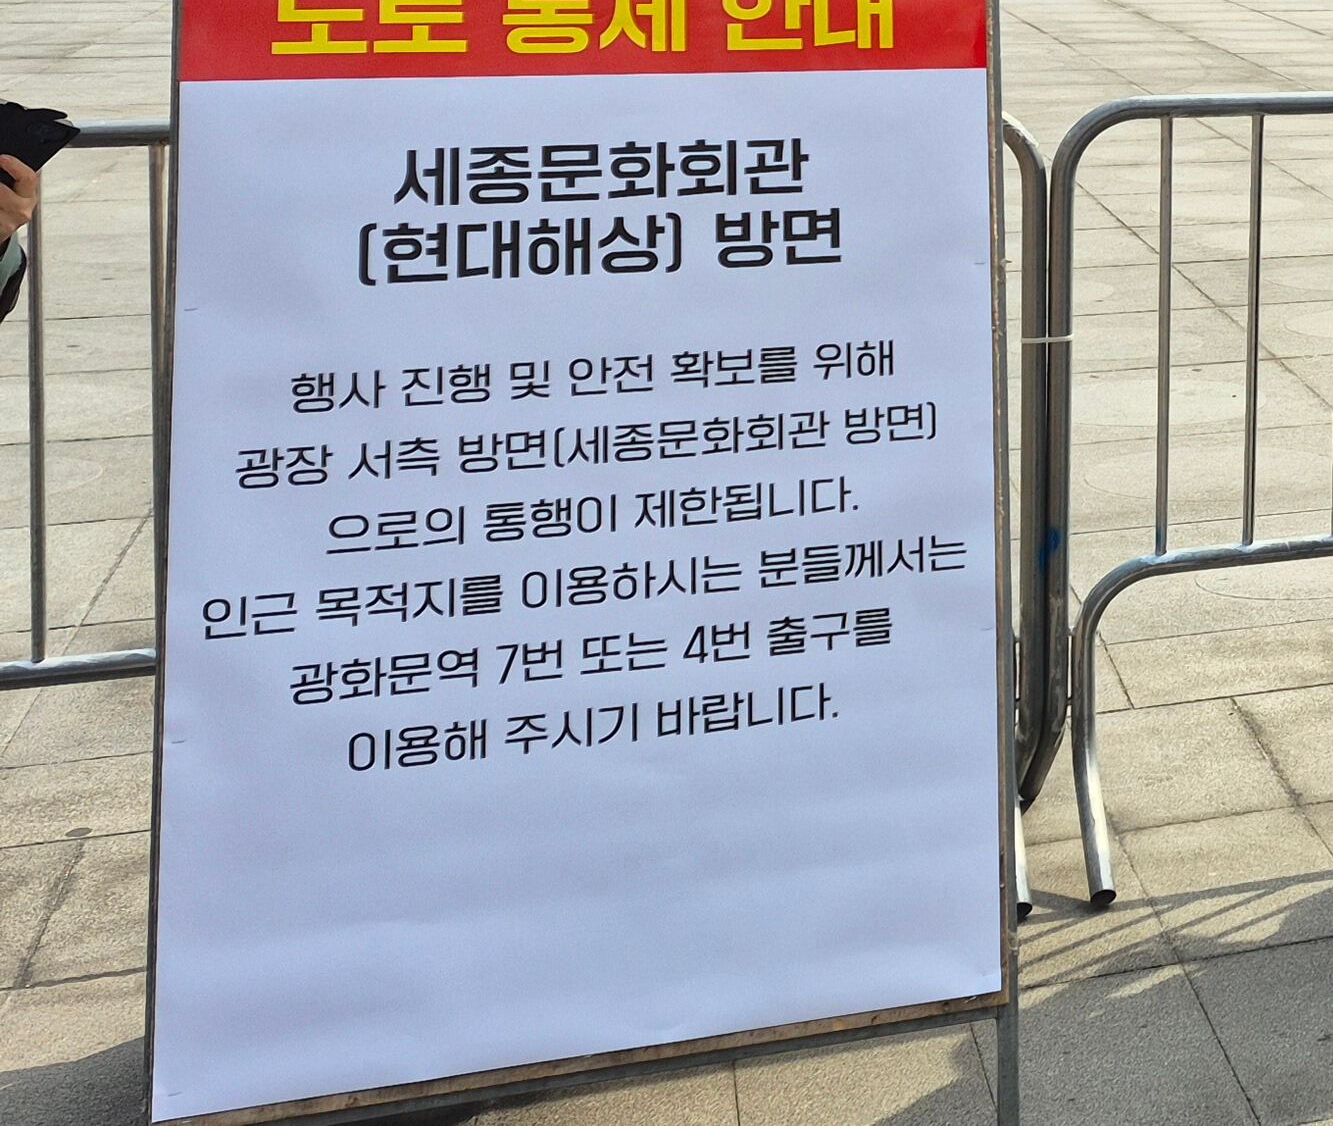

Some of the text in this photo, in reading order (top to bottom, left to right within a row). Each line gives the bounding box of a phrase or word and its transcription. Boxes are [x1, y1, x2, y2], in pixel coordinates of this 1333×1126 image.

[395, 139, 810, 206] 세종문화회관
[359, 208, 843, 288] (현대해상) 방면
[291, 340, 895, 414] 행사 진행 및 안전 확보를 위해
[236, 445, 334, 491] 광장
[349, 437, 441, 481] 서측
[845, 402, 938, 446] 방면)
[326, 476, 860, 555] 으로의 통행이 제한됩니다.
[203, 535, 968, 641] 인근 목적지를 이용하시는 분들께서는
[290, 608, 894, 706] 광화문역 7번 또는 4번 출구를
[349, 683, 840, 772] 이용해 주시기 바랍니다.
